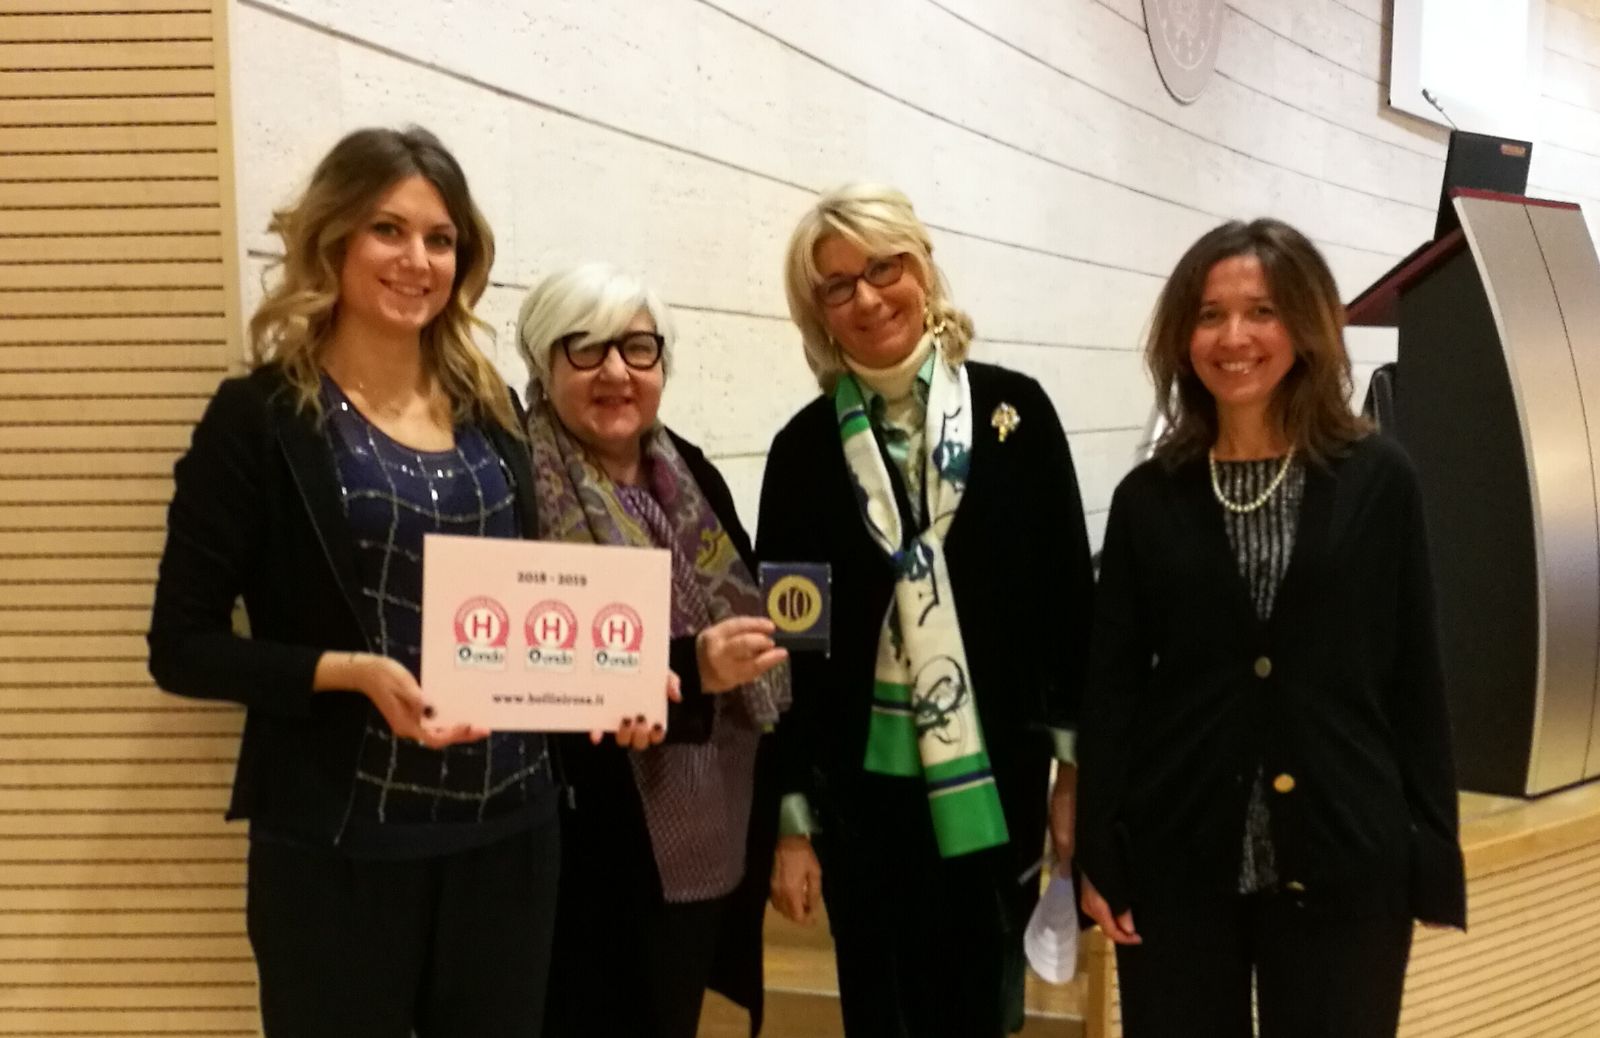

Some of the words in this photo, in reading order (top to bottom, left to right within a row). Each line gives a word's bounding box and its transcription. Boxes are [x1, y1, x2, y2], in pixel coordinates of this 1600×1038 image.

[517, 571, 547, 583] 2018
[557, 573, 587, 587] 2019
[472, 614, 491, 639] H
[542, 617, 560, 641] H
[608, 620, 626, 643] H
